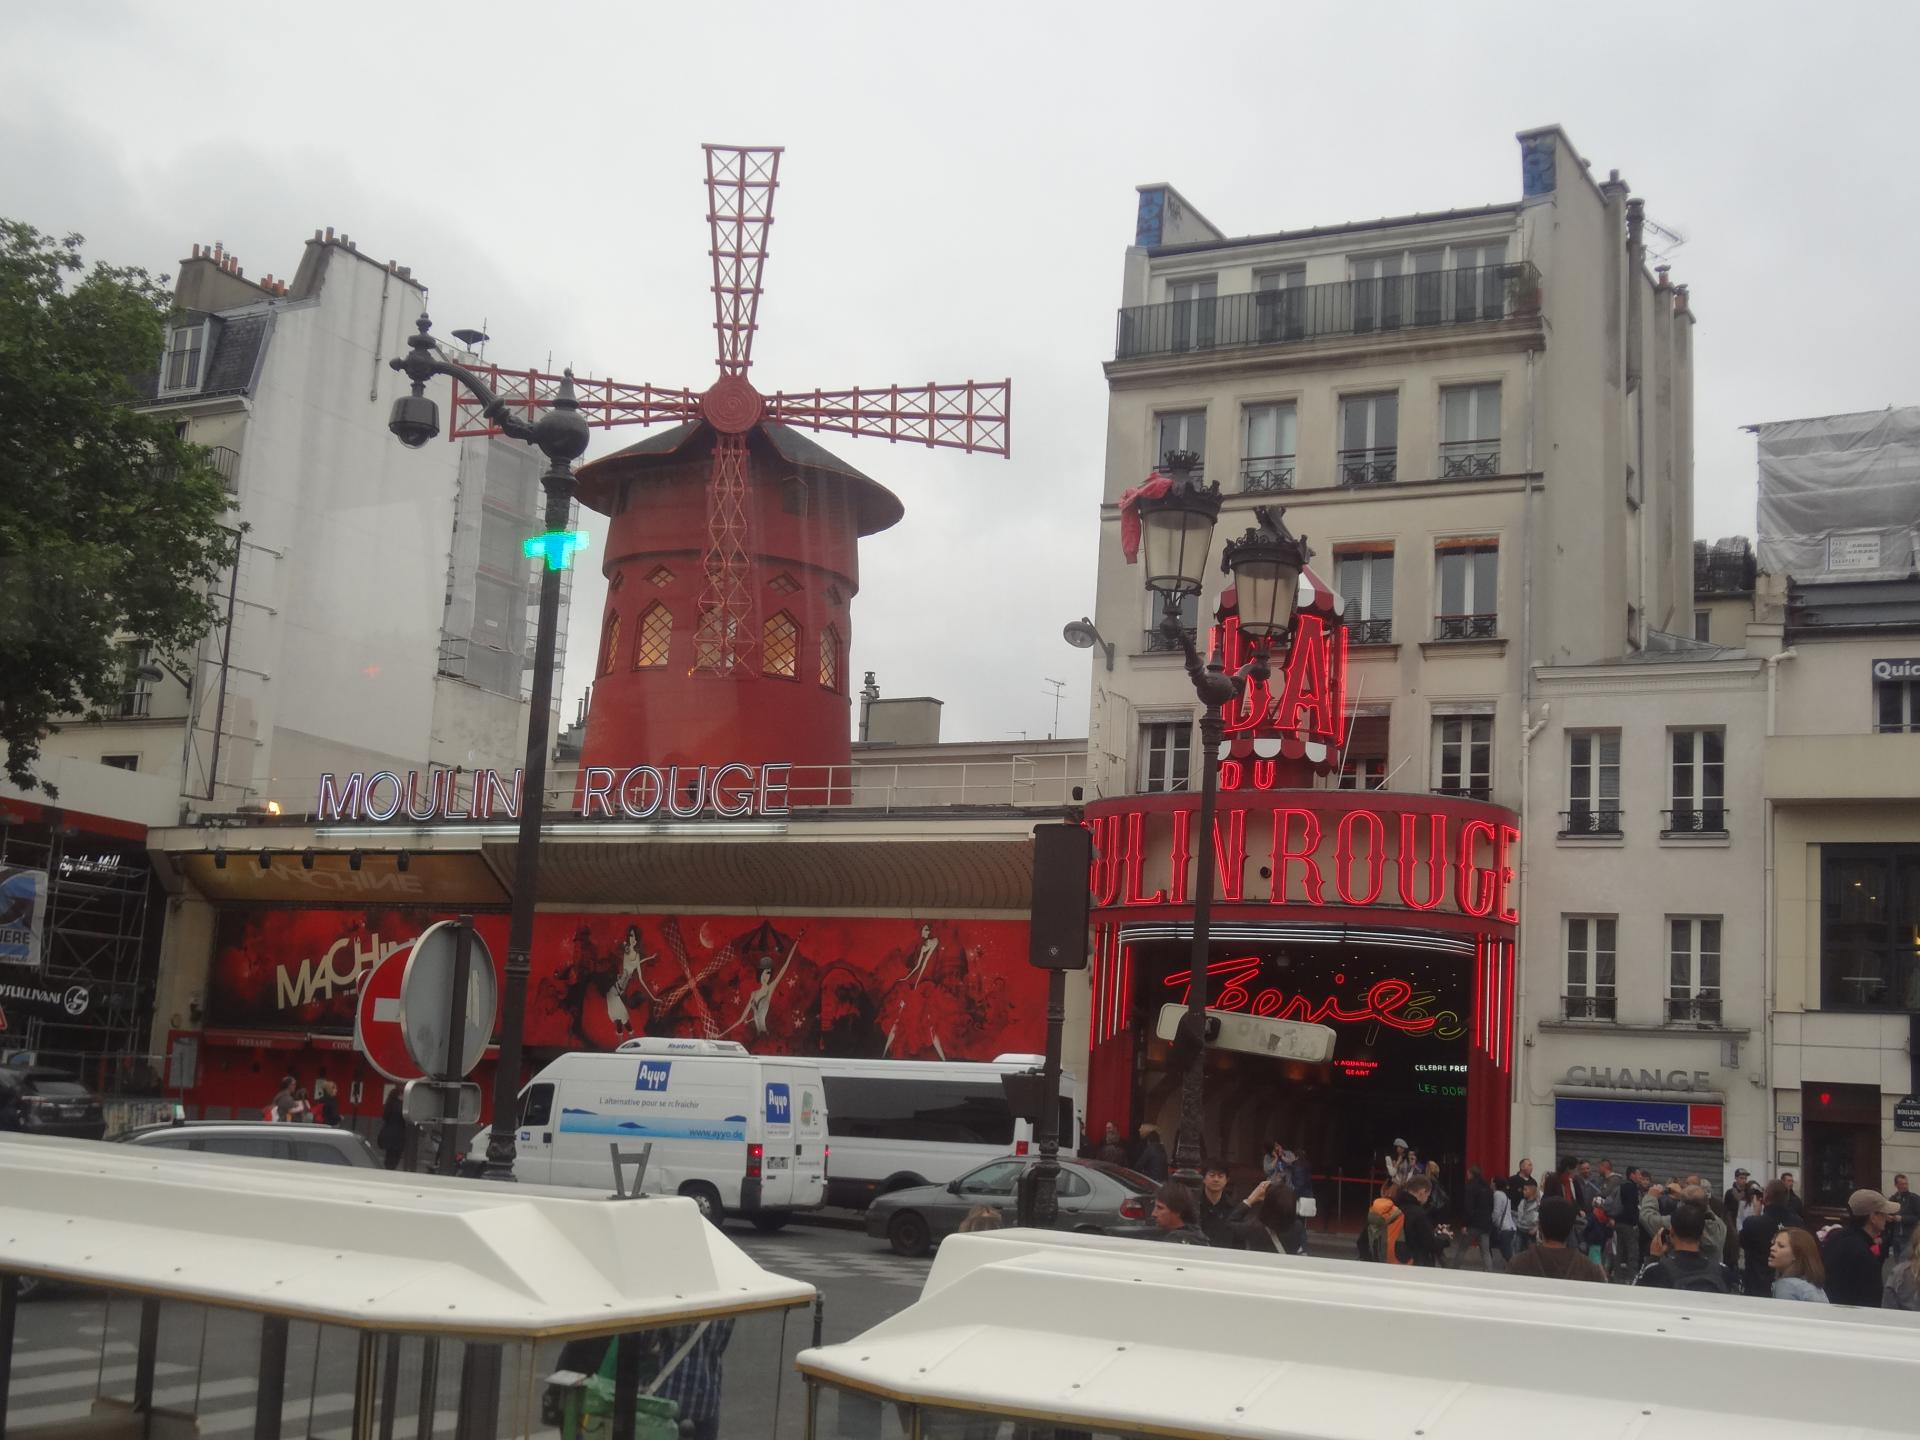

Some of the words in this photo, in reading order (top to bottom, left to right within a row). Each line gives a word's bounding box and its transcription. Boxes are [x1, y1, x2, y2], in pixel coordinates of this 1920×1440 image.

[1220, 760, 1275, 790] DU
[318, 768, 524, 821] MOULIN
[582, 762, 793, 818] ROUGE
[1270, 807, 1521, 923] ROUGE
[277, 932, 420, 1010] MACH
[639, 1064, 667, 1089] Ayyo
[1566, 1065, 1711, 1092] CHANGE
[641, 1099, 658, 1108] pour
[768, 1089, 788, 1115] Ayyo
[689, 1127, 744, 1140] www.ayyo.de
[1636, 1118, 1686, 1133] Travelex
